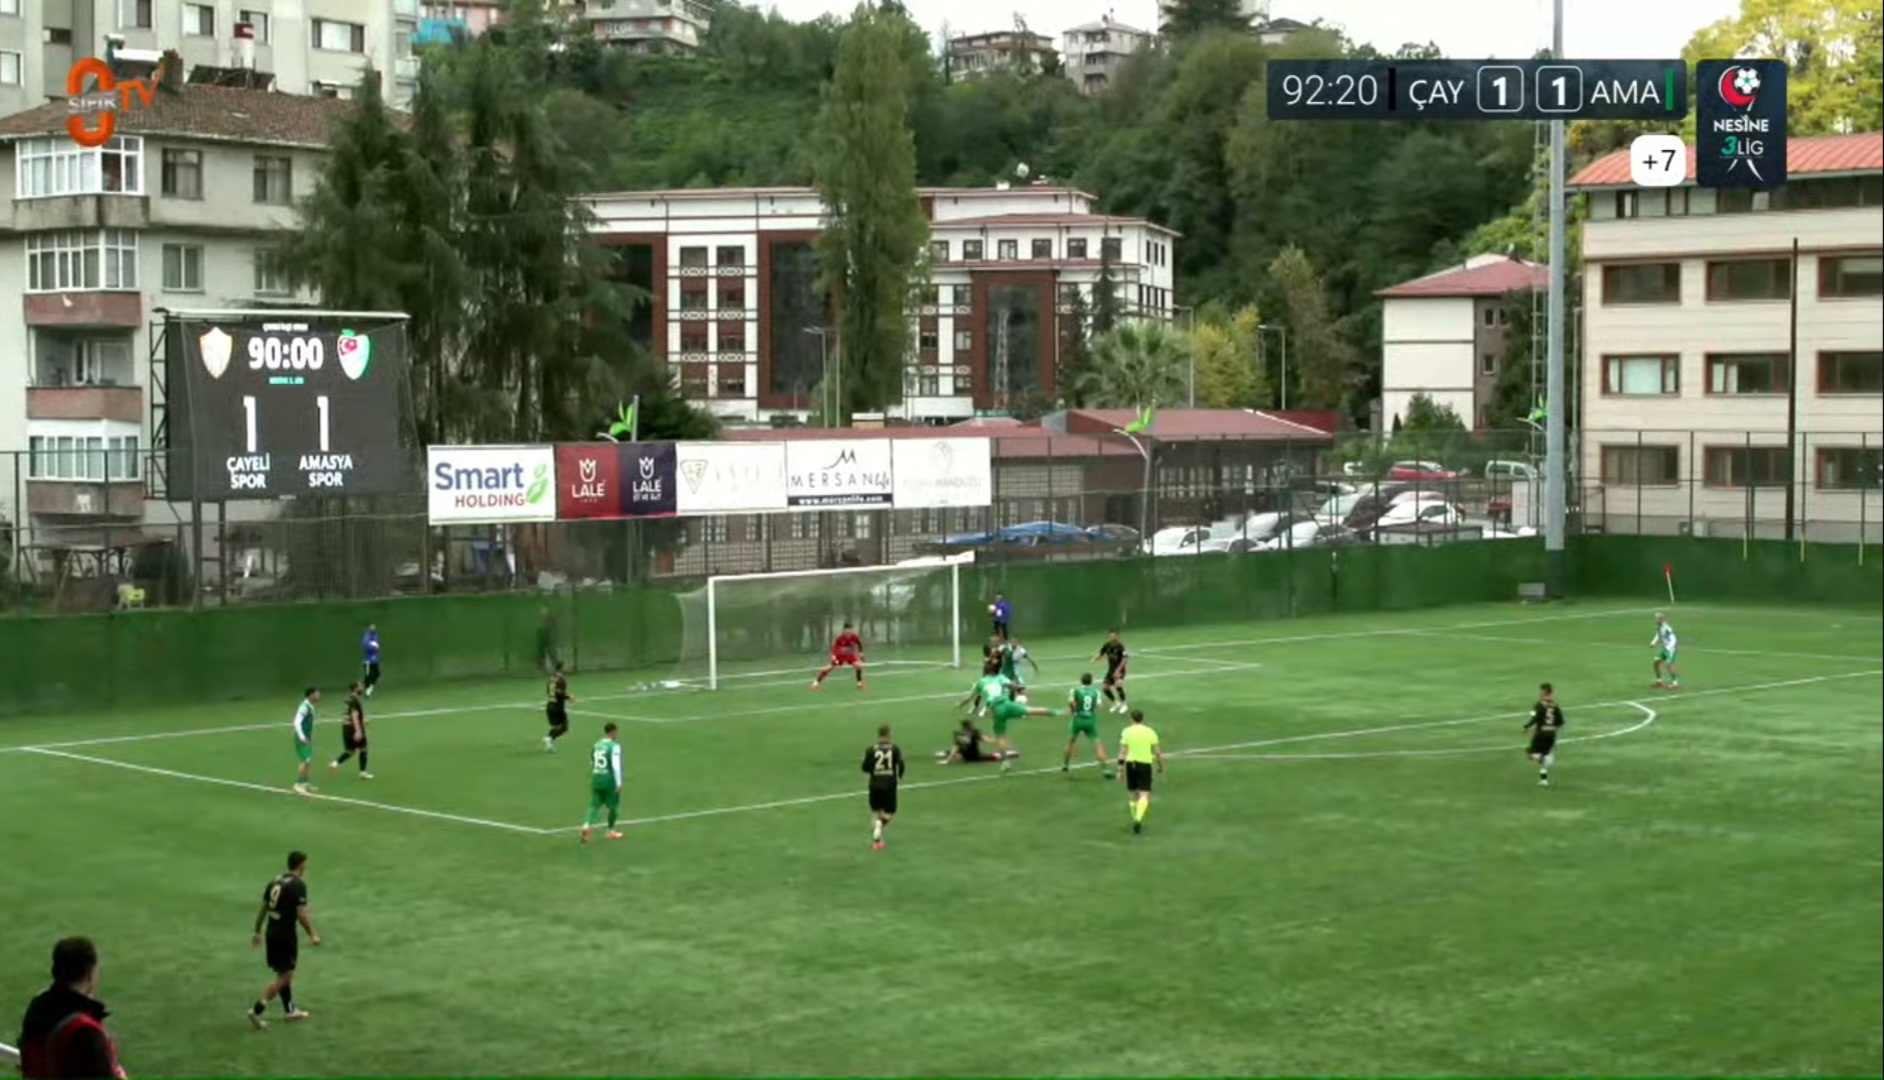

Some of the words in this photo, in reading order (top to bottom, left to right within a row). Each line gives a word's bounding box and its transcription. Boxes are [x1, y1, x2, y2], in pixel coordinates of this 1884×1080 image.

[248, 337, 323, 369] 90:00
[243, 396, 257, 452] 1
[317, 396, 329, 452] 1
[226, 453, 271, 474] ÇAYELİ
[299, 455, 353, 471] AMASYA
[230, 473, 266, 489] SPOR
[308, 472, 344, 487] SPOR
[434, 462, 524, 491] Smart
[632, 480, 662, 493] LALE
[571, 483, 606, 498] LALE
[455, 494, 525, 508] HOLDING
[1083, 695, 1092, 711] 8
[874, 750, 892, 770] 21
[269, 884, 281, 909] 9
